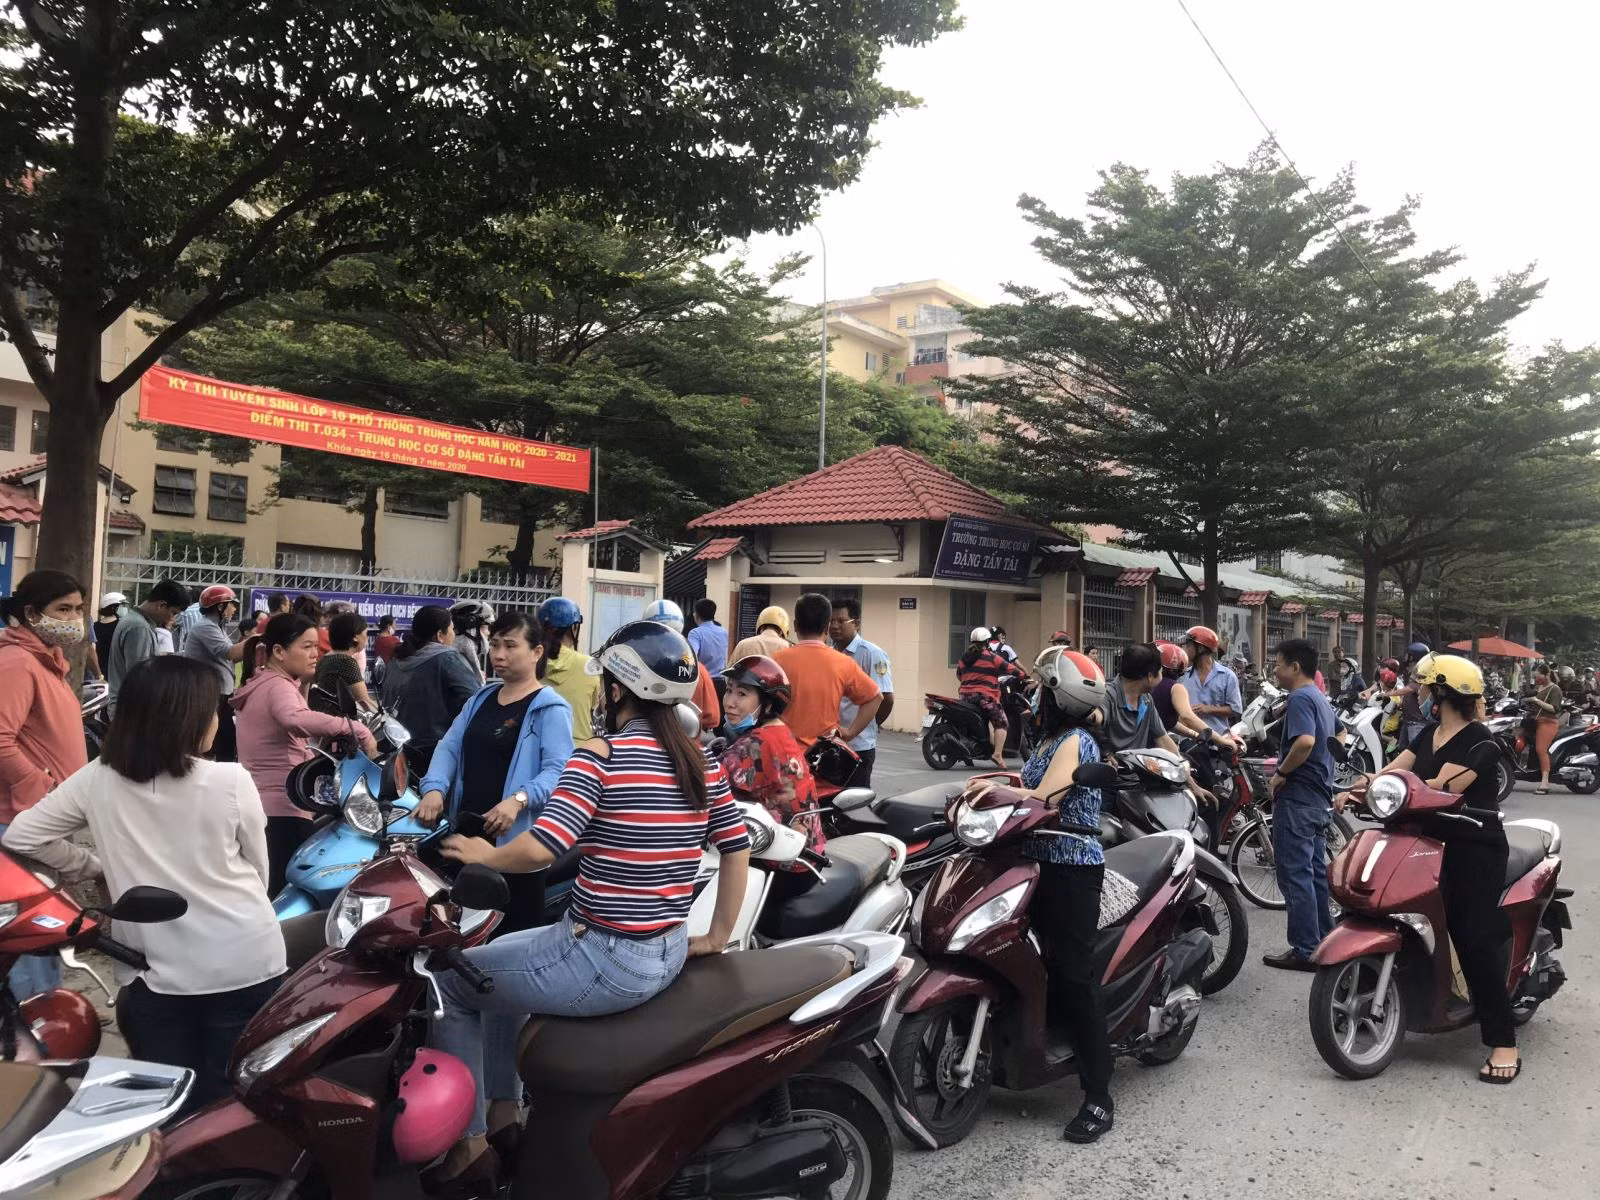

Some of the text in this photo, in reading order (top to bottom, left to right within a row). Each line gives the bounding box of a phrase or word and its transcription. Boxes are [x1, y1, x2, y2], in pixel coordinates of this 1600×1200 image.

[168, 376, 188, 391] KỲ
[193, 382, 217, 397] THI
[268, 397, 298, 412] SINH
[302, 403, 327, 417] LỚP
[331, 409, 346, 421] 10
[349, 412, 374, 426] PHỔ
[377, 418, 414, 434] THÔNG
[416, 424, 452, 440] TRUNG
[454, 433, 475, 445] HỌC
[478, 436, 500, 449] NĂM
[502, 441, 522, 452] HỌC
[524, 445, 548, 457] 2020
[555, 450, 576, 462] 2021
[250, 410, 284, 427] ĐIỂM
[288, 418, 309, 432] THI
[313, 423, 347, 438] T.034
[358, 431, 396, 447] TRUNG
[398, 438, 421, 452] HỌC
[424, 444, 440, 454] CƠ
[441, 446, 455, 457] SỞ
[488, 452, 507, 466] TẤN
[510, 458, 525, 469] TÀI
[326, 441, 352, 453] Khóa
[354, 448, 377, 459] ngày
[381, 451, 390, 459] 16
[392, 452, 418, 465] tháng
[427, 459, 446, 468] năm
[448, 462, 466, 471] 2020
[952, 531, 978, 546] TRƯỜNG
[978, 536, 998, 548] TRUNG
[998, 539, 1012, 551] HỌC
[983, 550, 1002, 570] TẤN
[374, 602, 392, 618] SOÁT
[986, 940, 1013, 956] HONDA
[764, 1020, 840, 1063] VISION
[318, 1116, 364, 1128] HONDA
